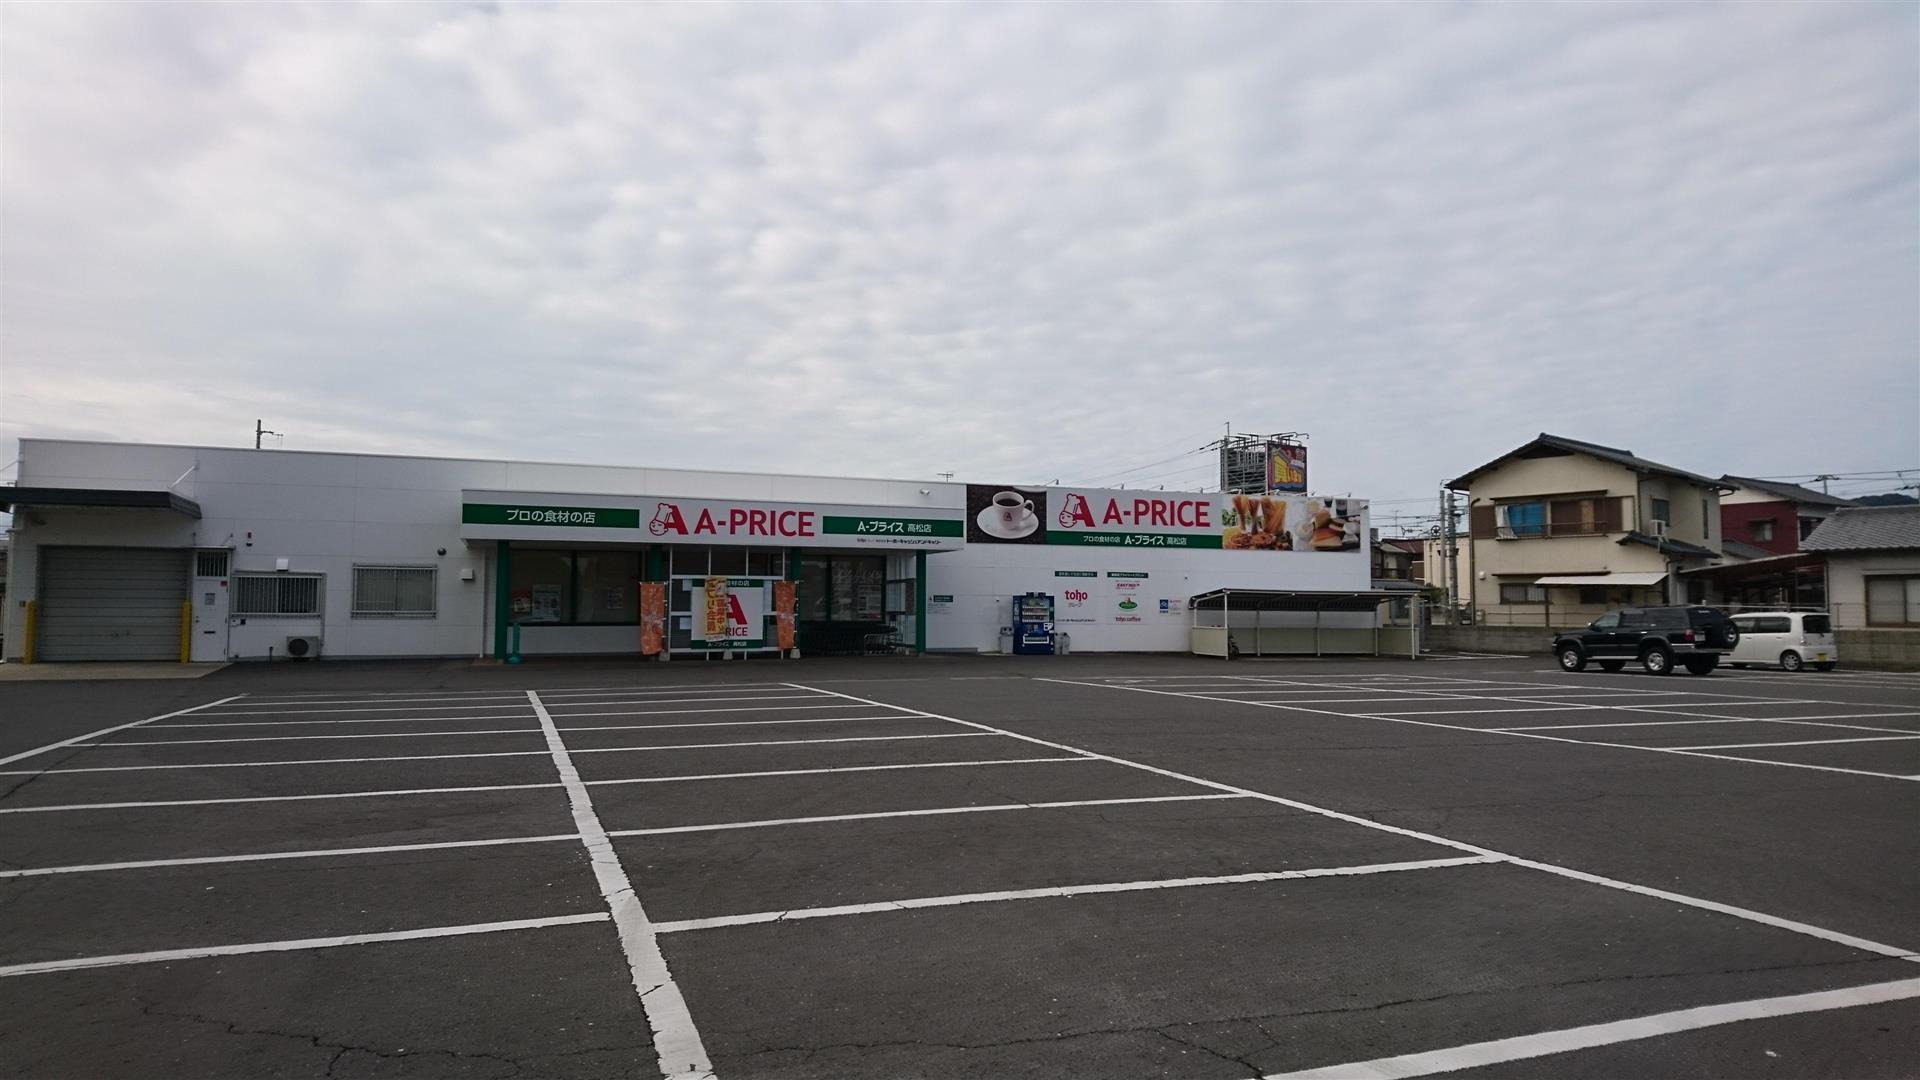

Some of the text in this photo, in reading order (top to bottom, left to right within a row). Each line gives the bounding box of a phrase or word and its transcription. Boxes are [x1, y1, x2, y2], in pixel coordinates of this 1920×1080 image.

[506, 509, 596, 524] プロの食材の店
[1103, 498, 1211, 527] A-PRICE
[694, 508, 814, 537] A-PRICE
[907, 523, 932, 533] 高松店
[1083, 535, 1121, 543] プロの食材の店
[1166, 537, 1187, 545] 高松店
[1065, 589, 1088, 601] toho
